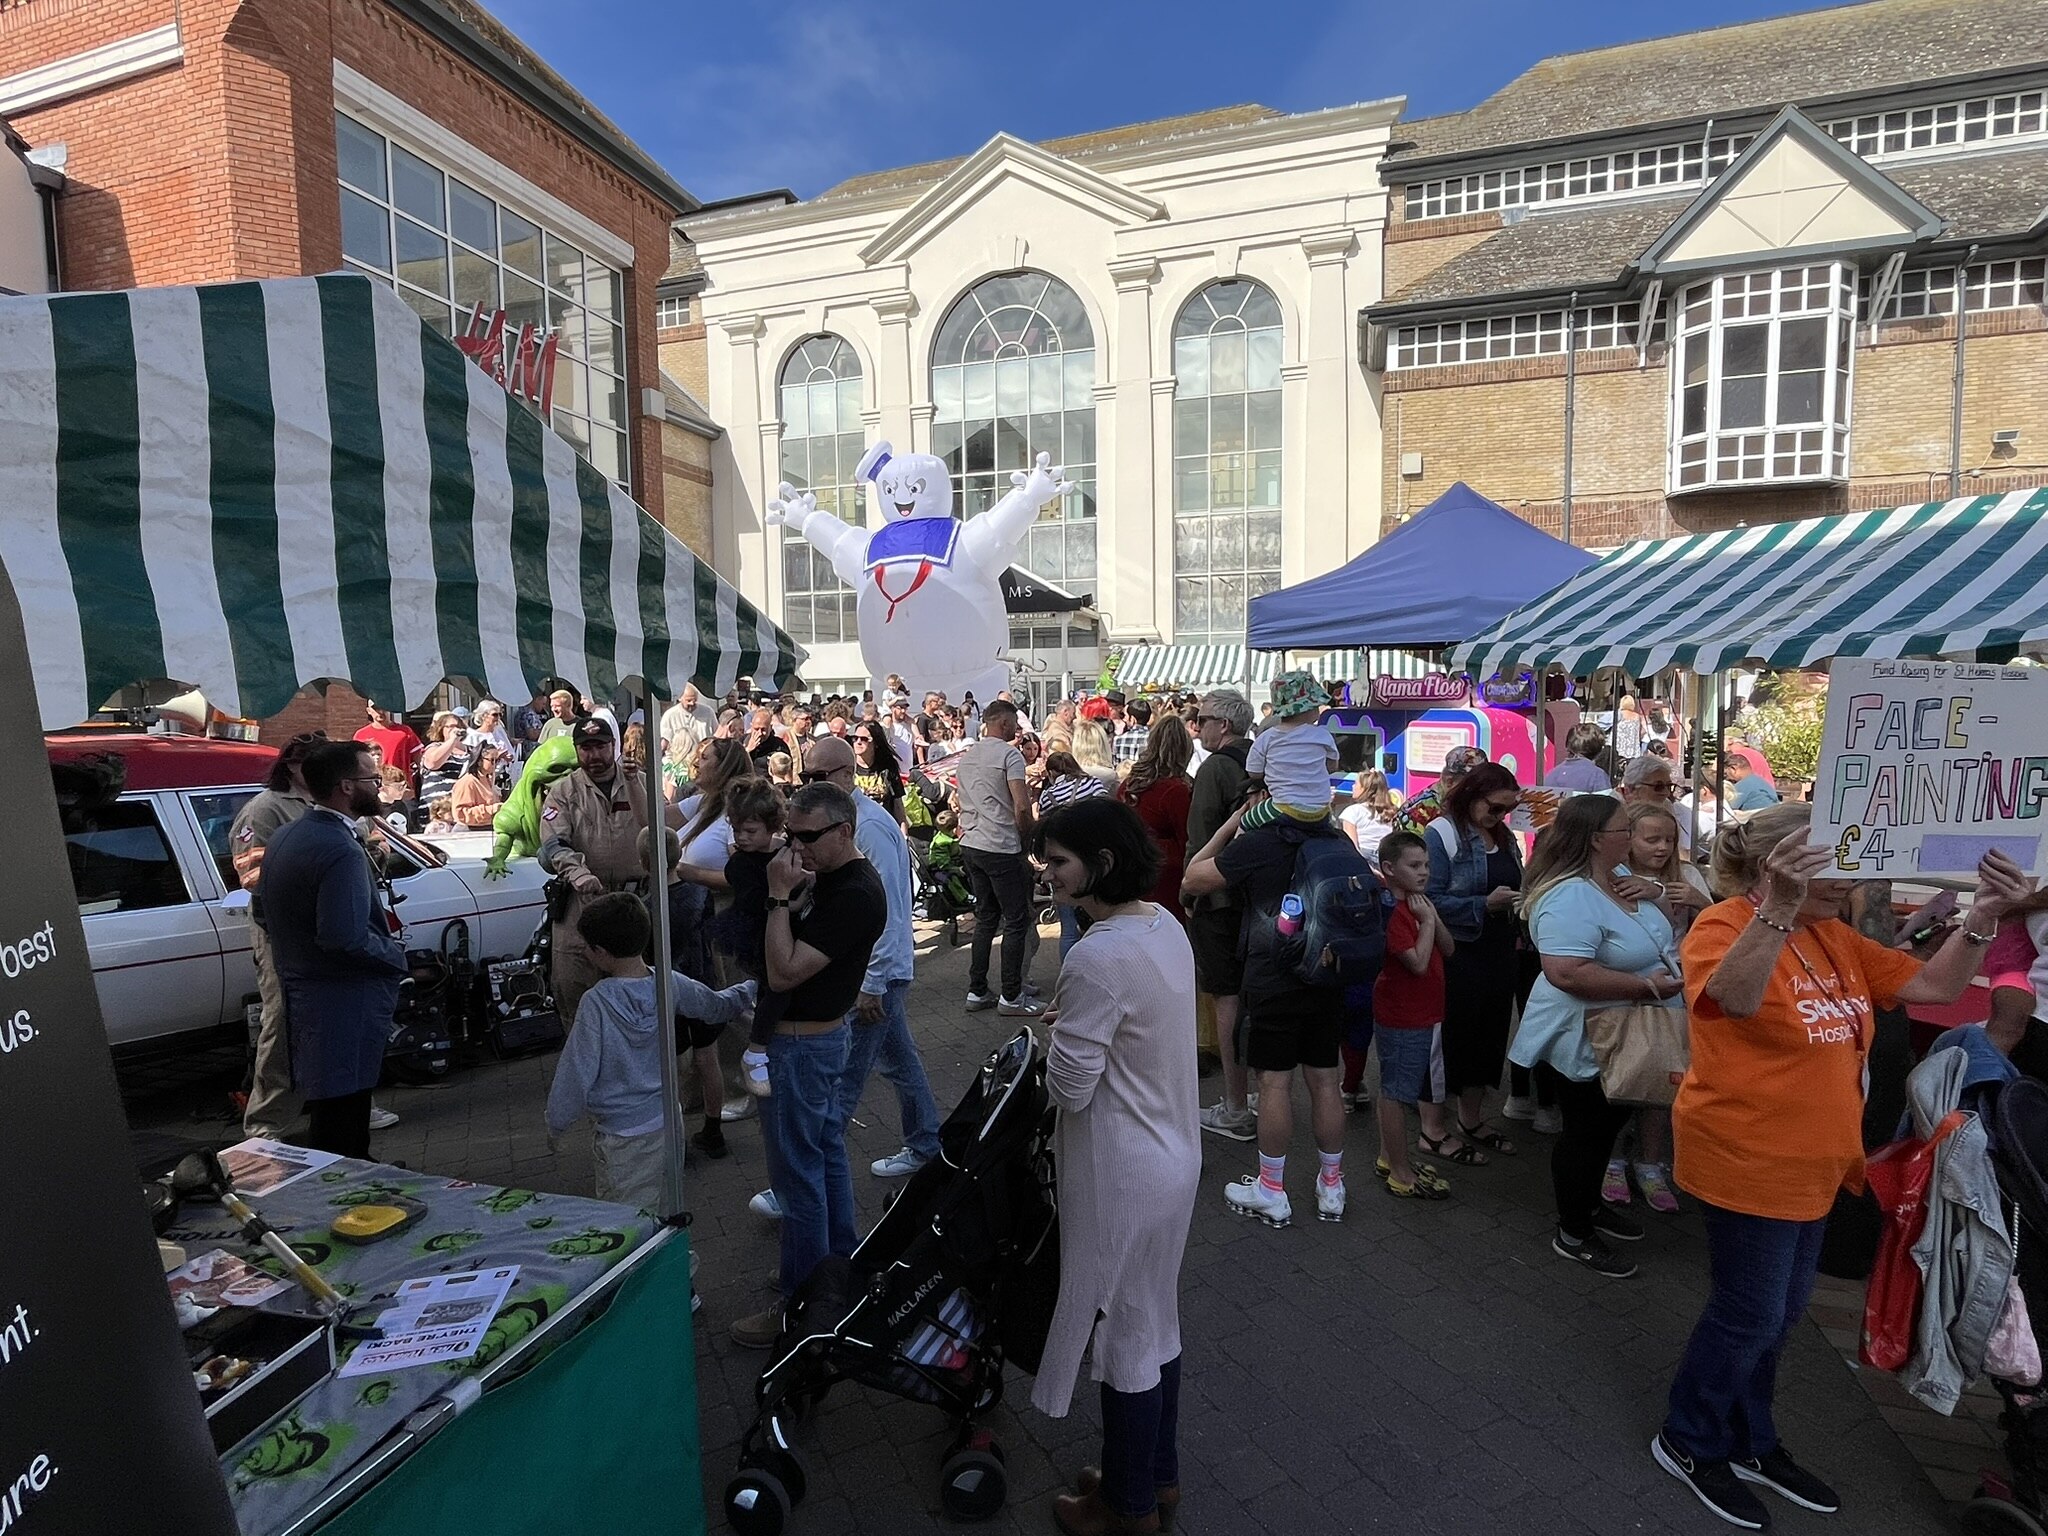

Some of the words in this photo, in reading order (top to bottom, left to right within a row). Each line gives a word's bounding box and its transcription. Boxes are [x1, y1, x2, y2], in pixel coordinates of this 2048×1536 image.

[1872, 662, 1896, 676] Fund
[1375, 677, 1422, 702] Llama
[1424, 675, 1463, 697] Floss
[1834, 824, 1895, 872] £4
[887, 1270, 944, 1328] MACLAREN
[366, 1337, 414, 1350] BACK!
[416, 1327, 478, 1342] THEY'RE
